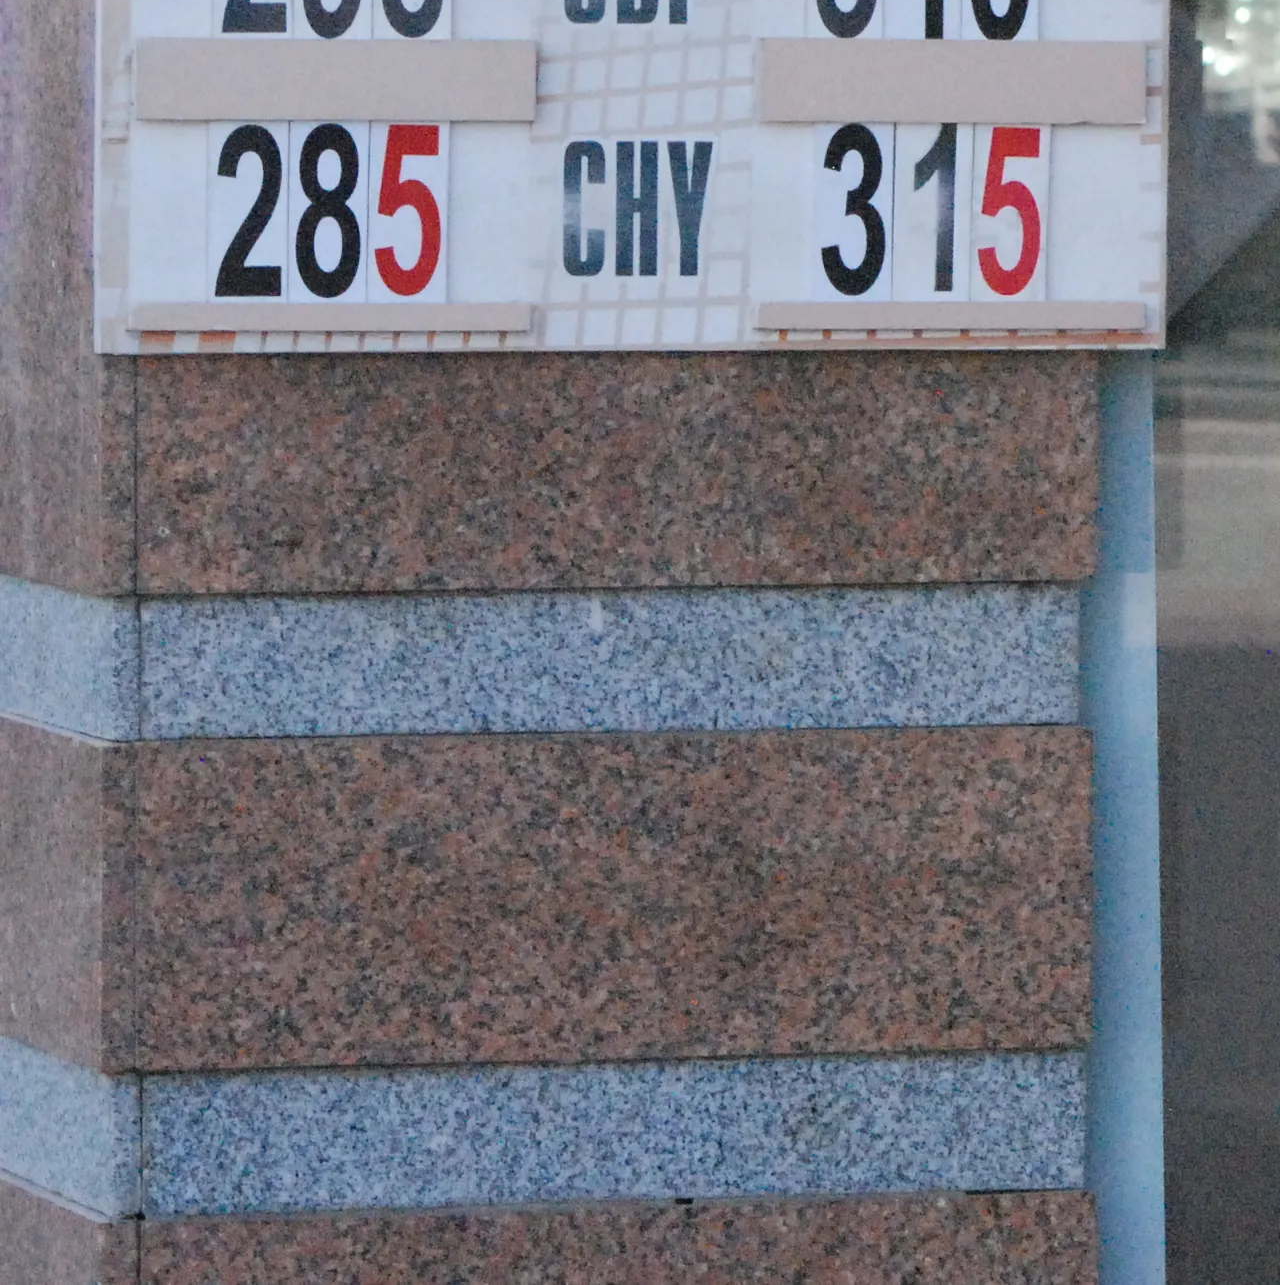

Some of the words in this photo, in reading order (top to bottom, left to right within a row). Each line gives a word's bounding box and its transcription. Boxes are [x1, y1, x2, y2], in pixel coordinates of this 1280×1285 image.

[213, 123, 443, 300] 285
[562, 139, 714, 278] CHY
[819, 122, 1042, 297] 315
